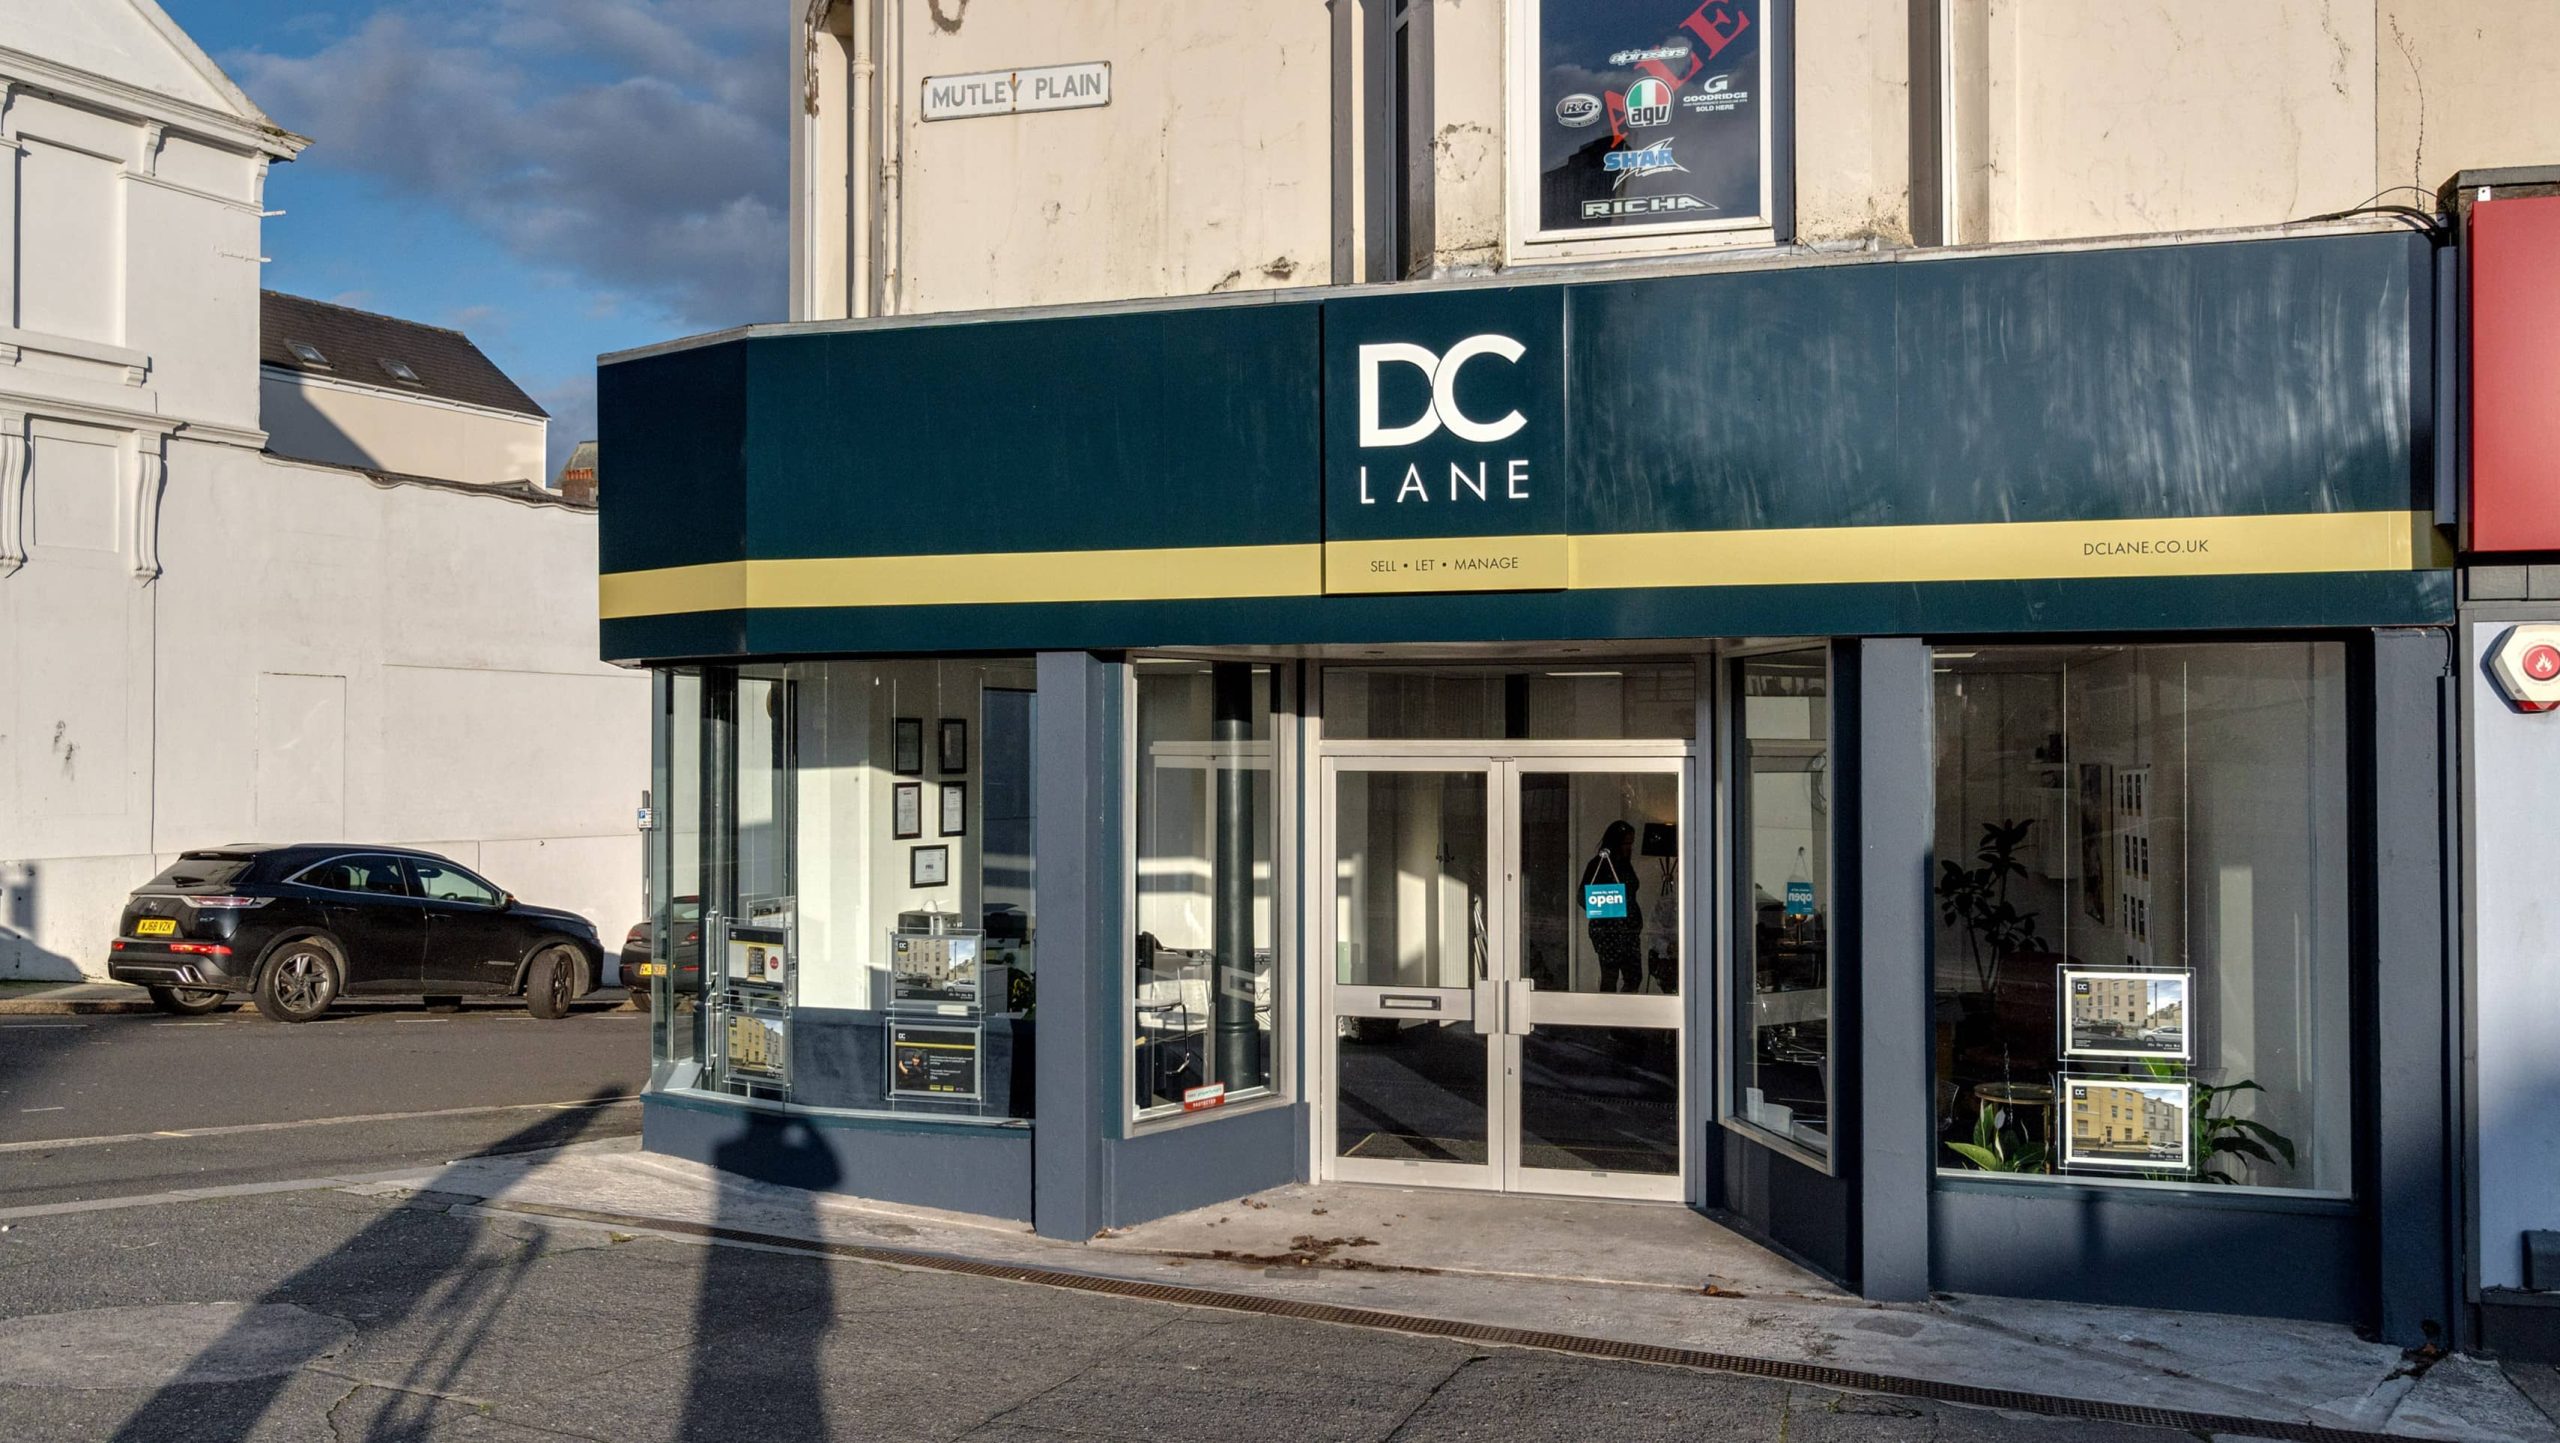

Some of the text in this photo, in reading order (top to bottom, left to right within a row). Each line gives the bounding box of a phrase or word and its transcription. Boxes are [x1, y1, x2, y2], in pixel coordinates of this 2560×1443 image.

[932, 72, 1101, 108] MUTLEY PLAIN
[1683, 91, 1748, 102] GOODRIDGE
[1565, 102, 1593, 113] R&G
[1631, 106, 1667, 125] agv
[1716, 103, 1734, 111] HERE
[1586, 196, 1706, 215] RICHA
[1359, 334, 1527, 448] DC
[1360, 460, 1529, 504] LANE
[2083, 539, 2209, 556] DCLANE.CO.UK
[1370, 556, 1519, 573] SELL LET MANAGE
[1588, 895, 1623, 907] open
